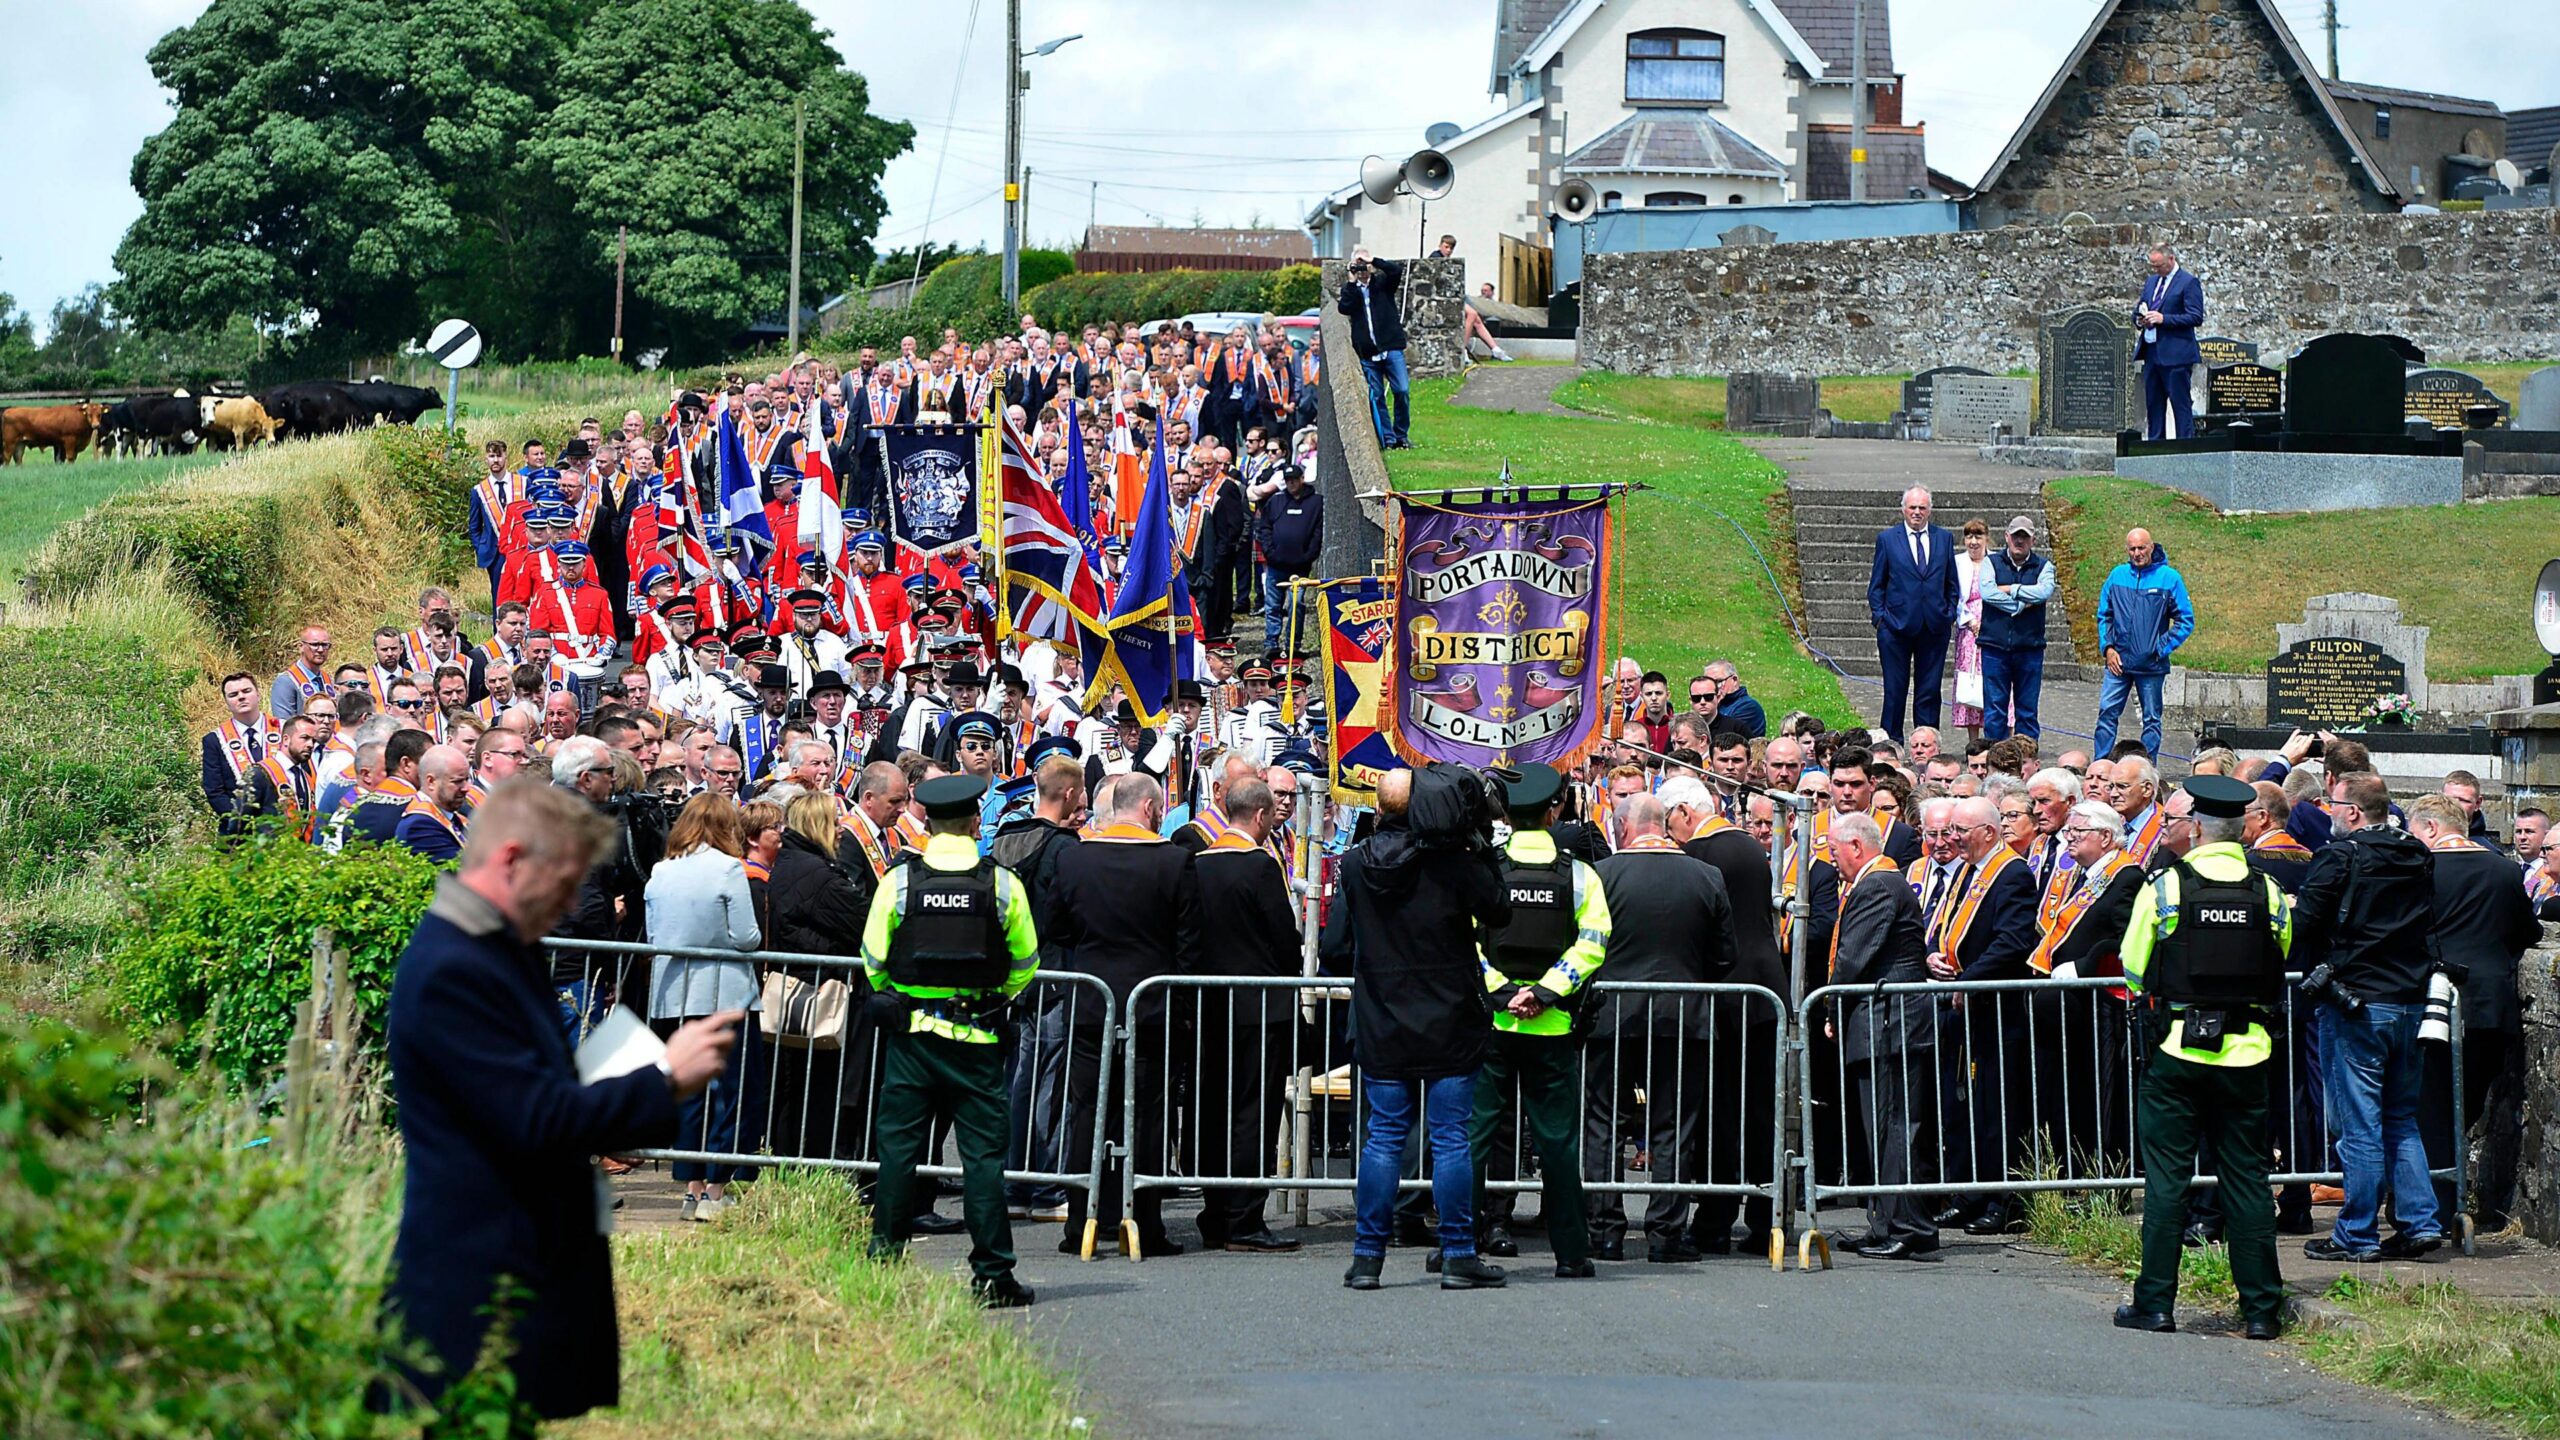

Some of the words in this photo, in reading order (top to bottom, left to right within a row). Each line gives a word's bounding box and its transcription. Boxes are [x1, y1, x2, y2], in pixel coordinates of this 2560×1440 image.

[2199, 342, 2236, 351] WRIGHT
[2234, 367, 2259, 375] BEST
[2423, 378, 2458, 390] WOOD
[1074, 525, 1098, 550] 914
[1420, 554, 1576, 600] PORTADOWN
[1118, 632, 1152, 650] LIBERTY
[1426, 632, 1574, 662] DISTRICT
[2310, 642, 2362, 653] FULTON
[2307, 653, 2333, 662] Loving
[2336, 654, 2366, 662] Memory
[924, 894, 970, 908] POLICE
[1510, 889, 1554, 902] POLICE
[2201, 910, 2246, 922] POLICE
